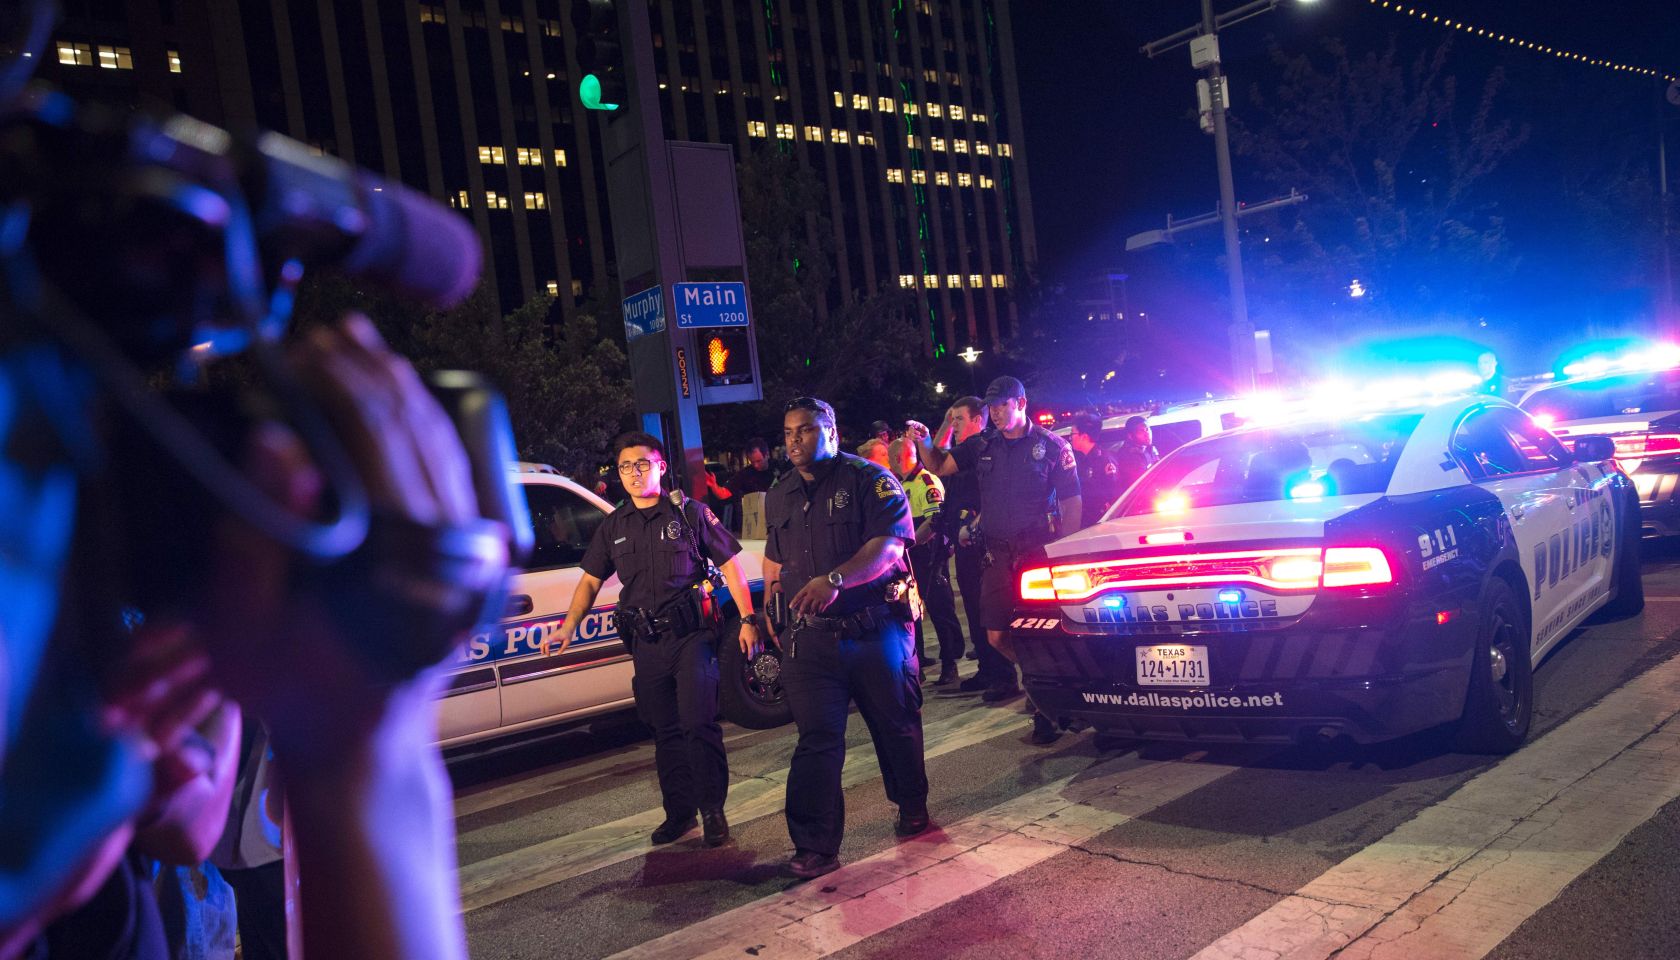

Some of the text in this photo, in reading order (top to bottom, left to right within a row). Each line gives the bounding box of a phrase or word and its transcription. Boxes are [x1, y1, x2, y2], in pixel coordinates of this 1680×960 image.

[684, 285, 736, 306] Main
[624, 293, 661, 320] Murphy
[681, 312, 745, 324] St 1200
[1422, 548, 1459, 570] EMERGENCY
[1534, 512, 1600, 601] POLICE
[1083, 600, 1279, 624] DALLAS POLICE
[1010, 617, 1060, 629] 4219
[1157, 648, 1185, 656] TEXAS
[1082, 692, 1283, 710] www.dallaspolice.net
